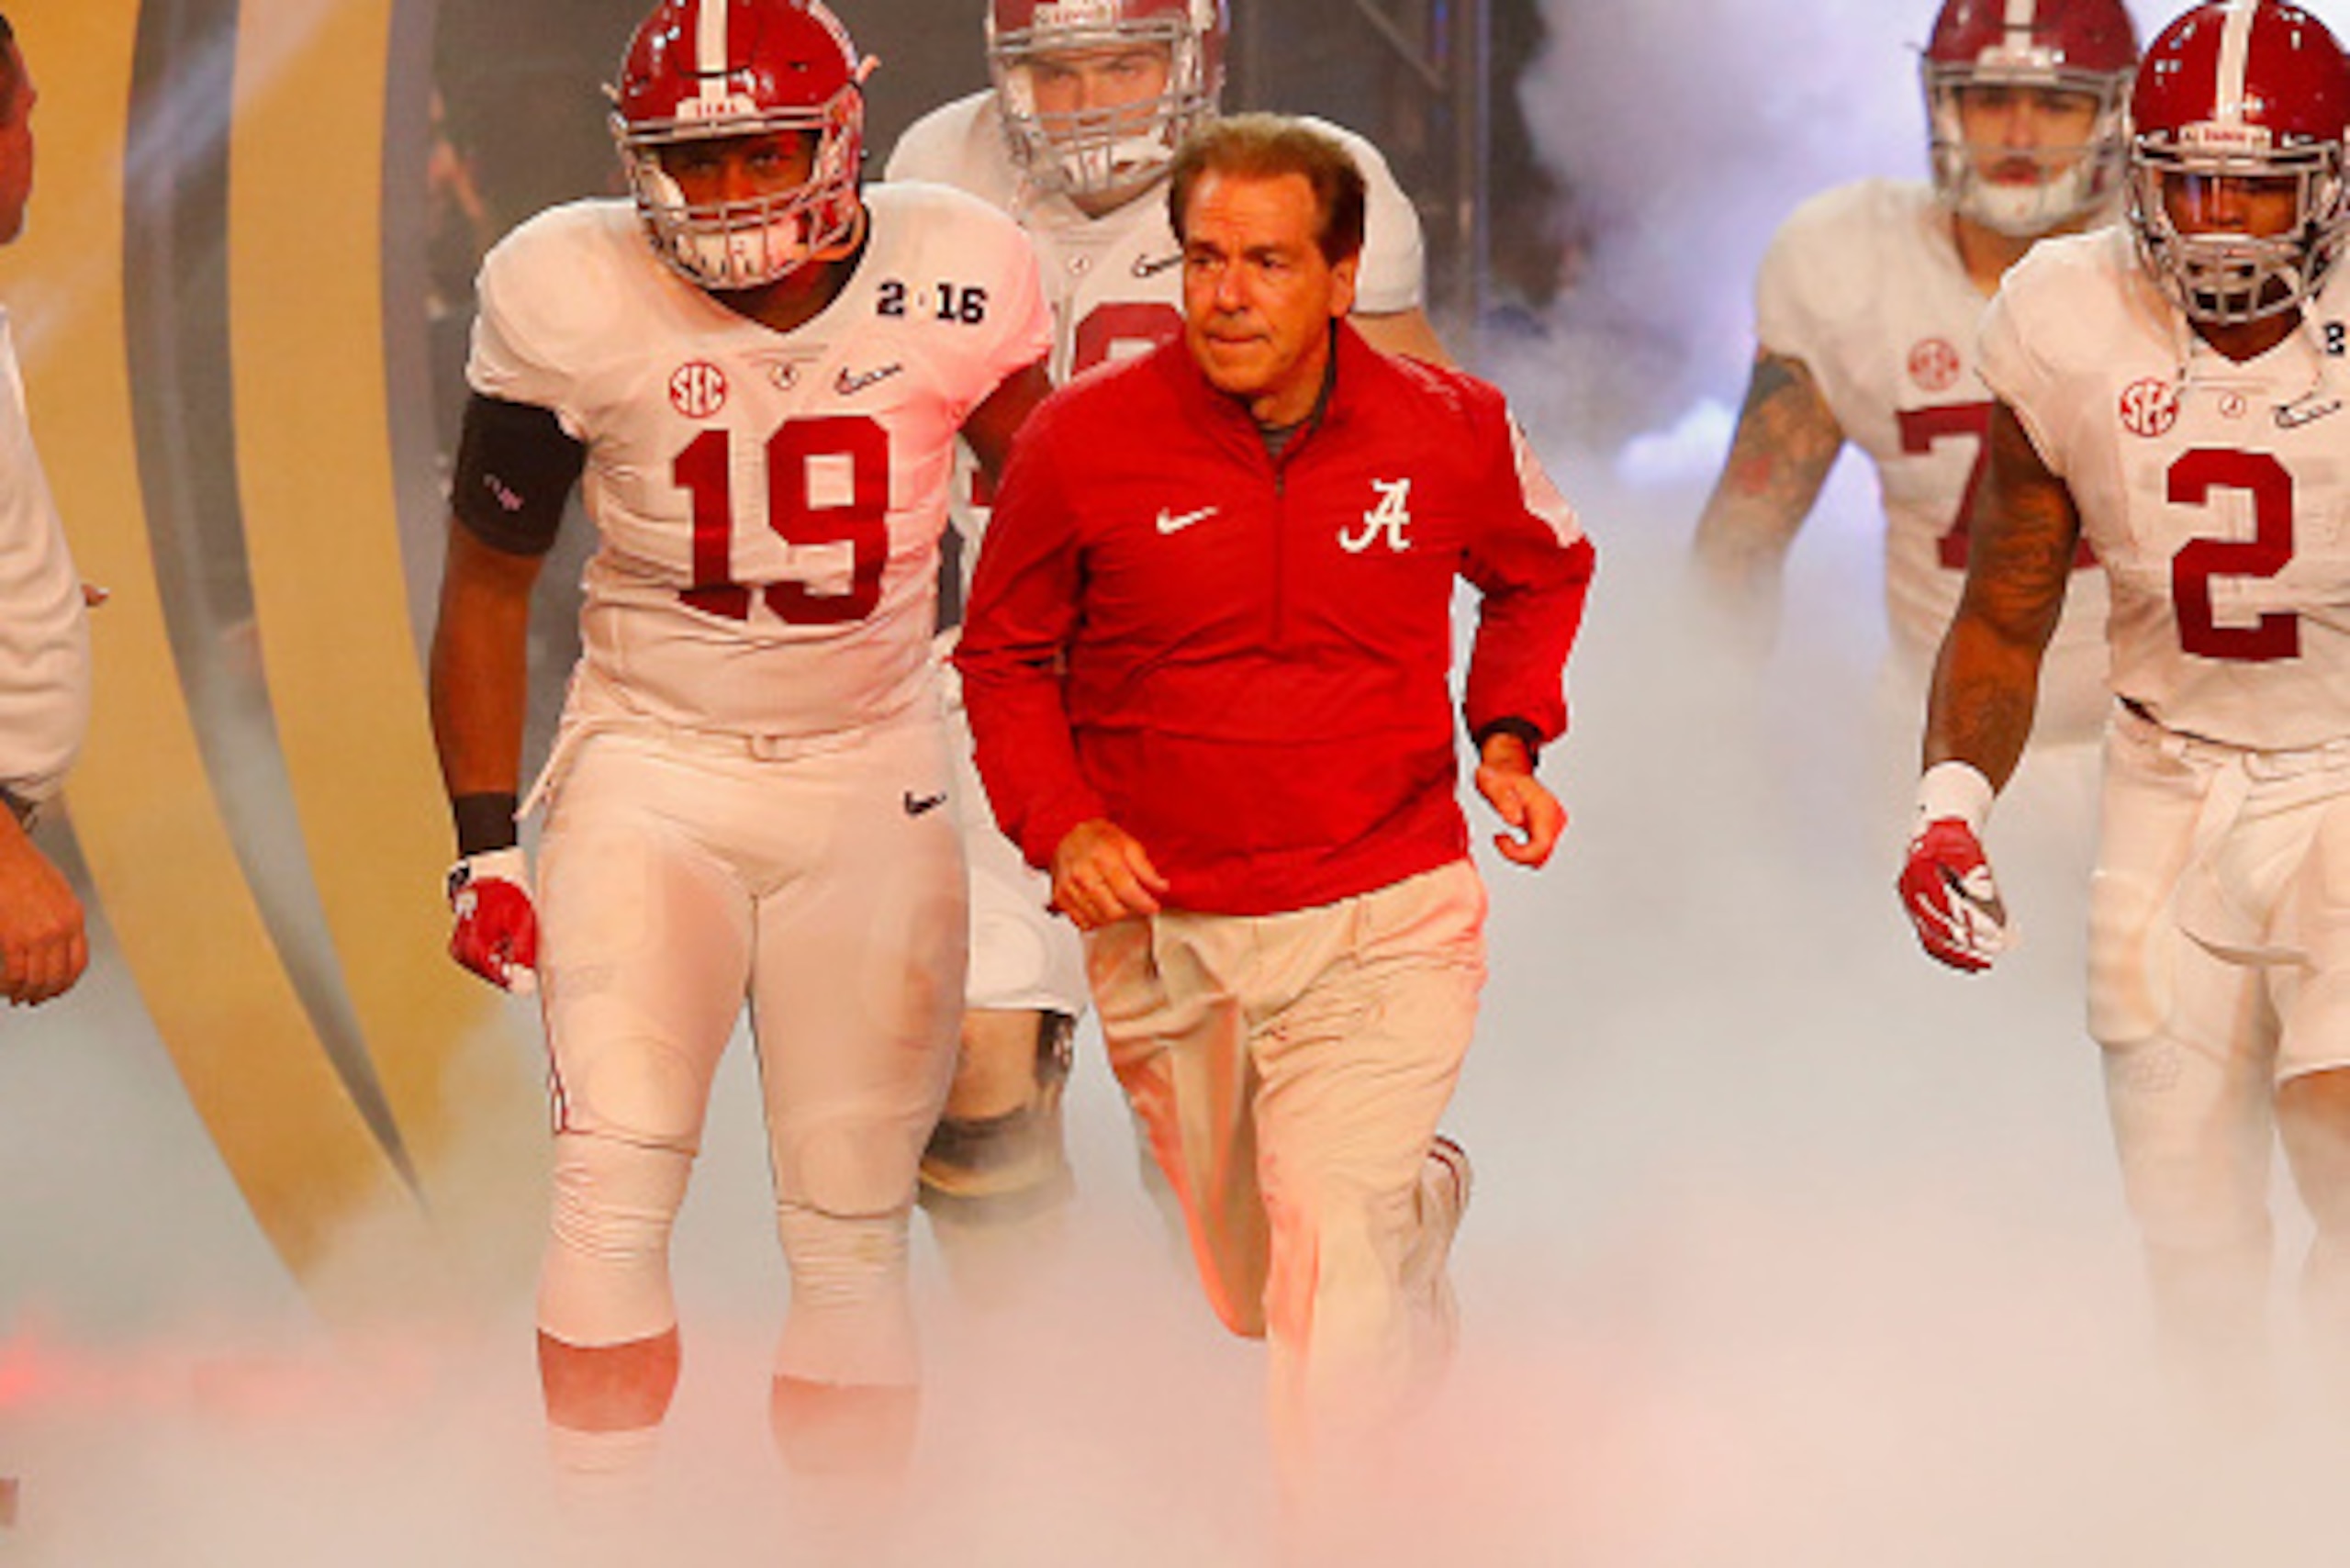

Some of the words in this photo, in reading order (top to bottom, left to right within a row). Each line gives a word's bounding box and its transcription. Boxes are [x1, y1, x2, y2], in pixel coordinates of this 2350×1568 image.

[671, 360, 725, 418] SEC
[673, 416, 890, 625] 19
[1337, 476, 1411, 553] A
[2167, 448, 2300, 660] 2
